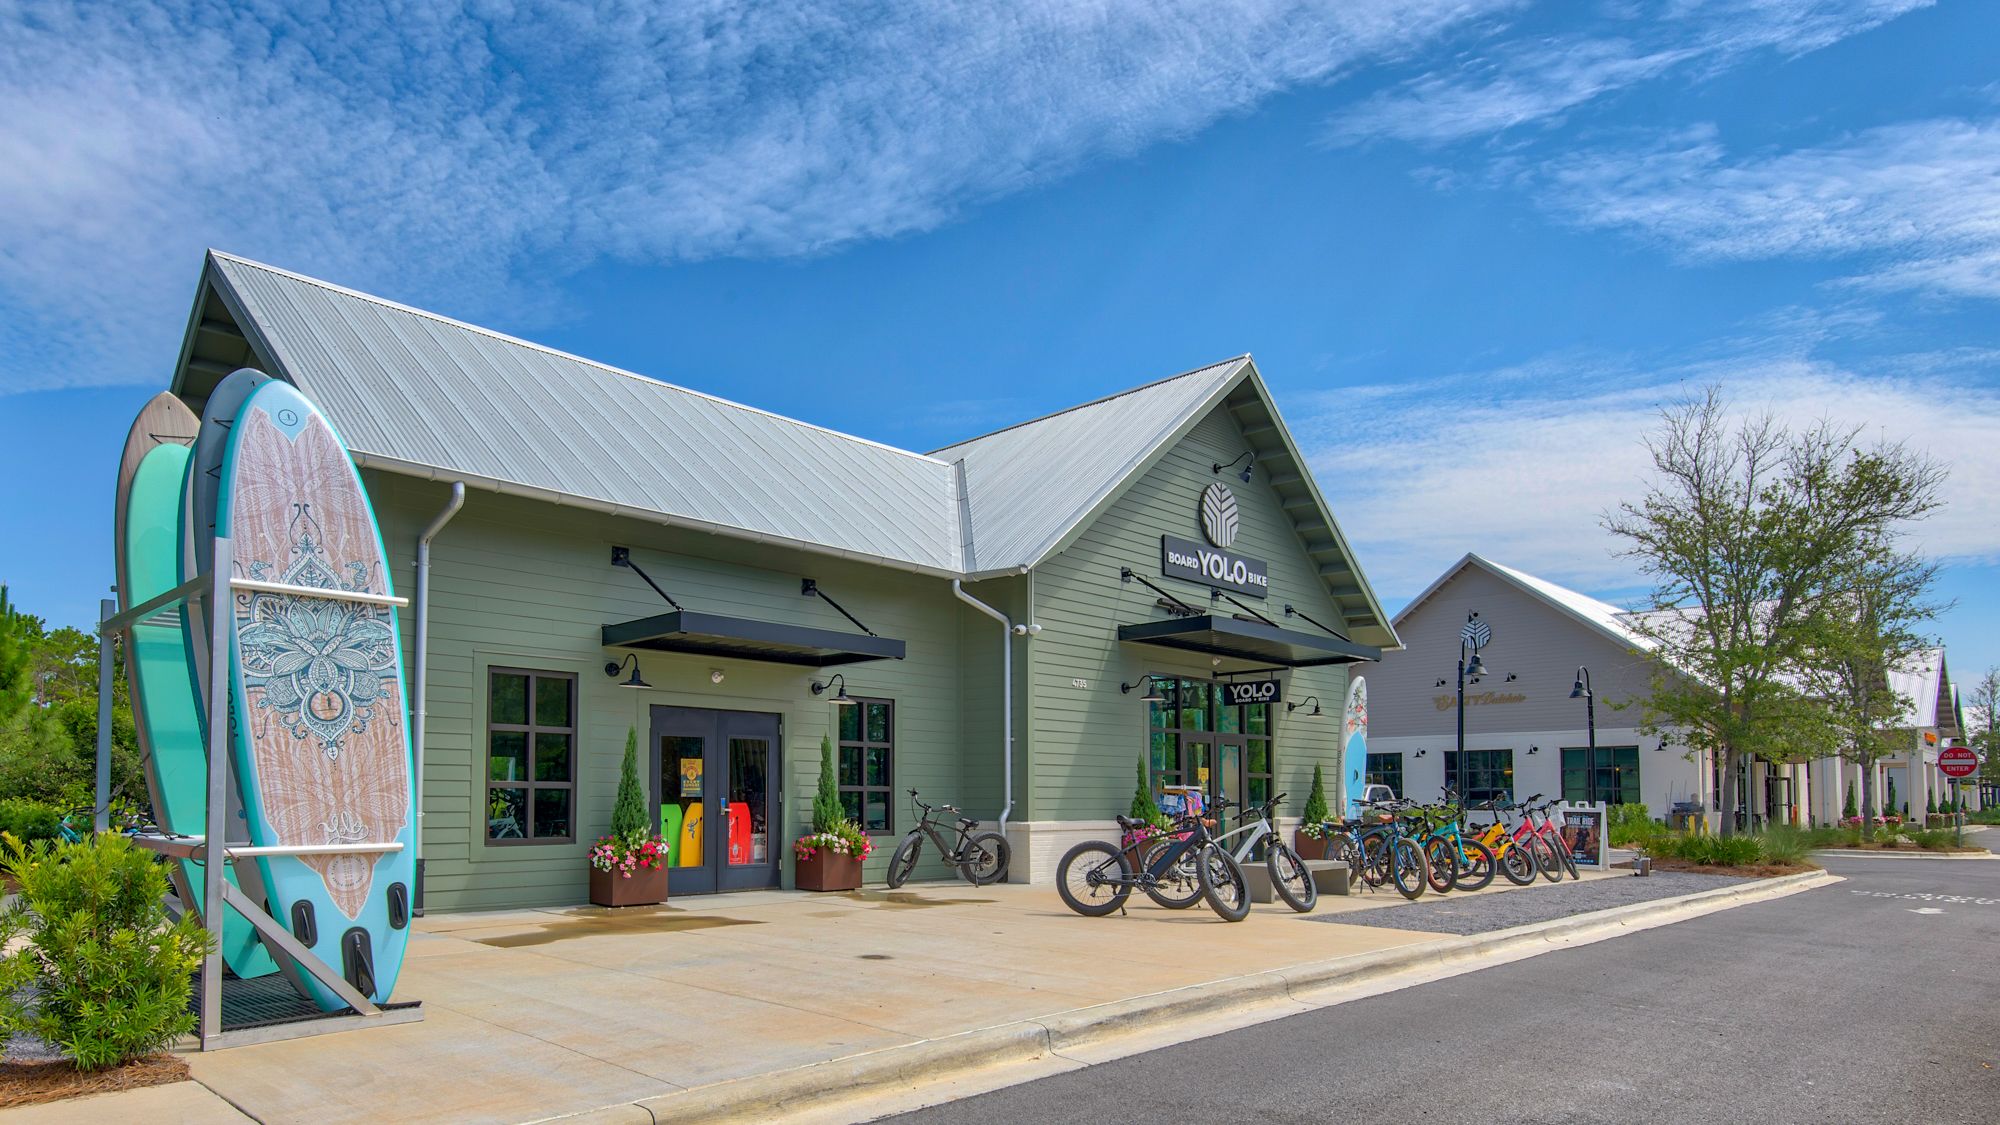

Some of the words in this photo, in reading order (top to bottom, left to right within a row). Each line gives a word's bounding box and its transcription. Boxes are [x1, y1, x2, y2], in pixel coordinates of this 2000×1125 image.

[1167, 551, 1198, 569] BOARD
[1196, 550, 1247, 585] YOLO
[1248, 572, 1267, 587] BIKE
[1229, 682, 1275, 699] YOLO
[1567, 817, 1580, 825] TRAIL
[1582, 817, 1594, 825] RIDE
